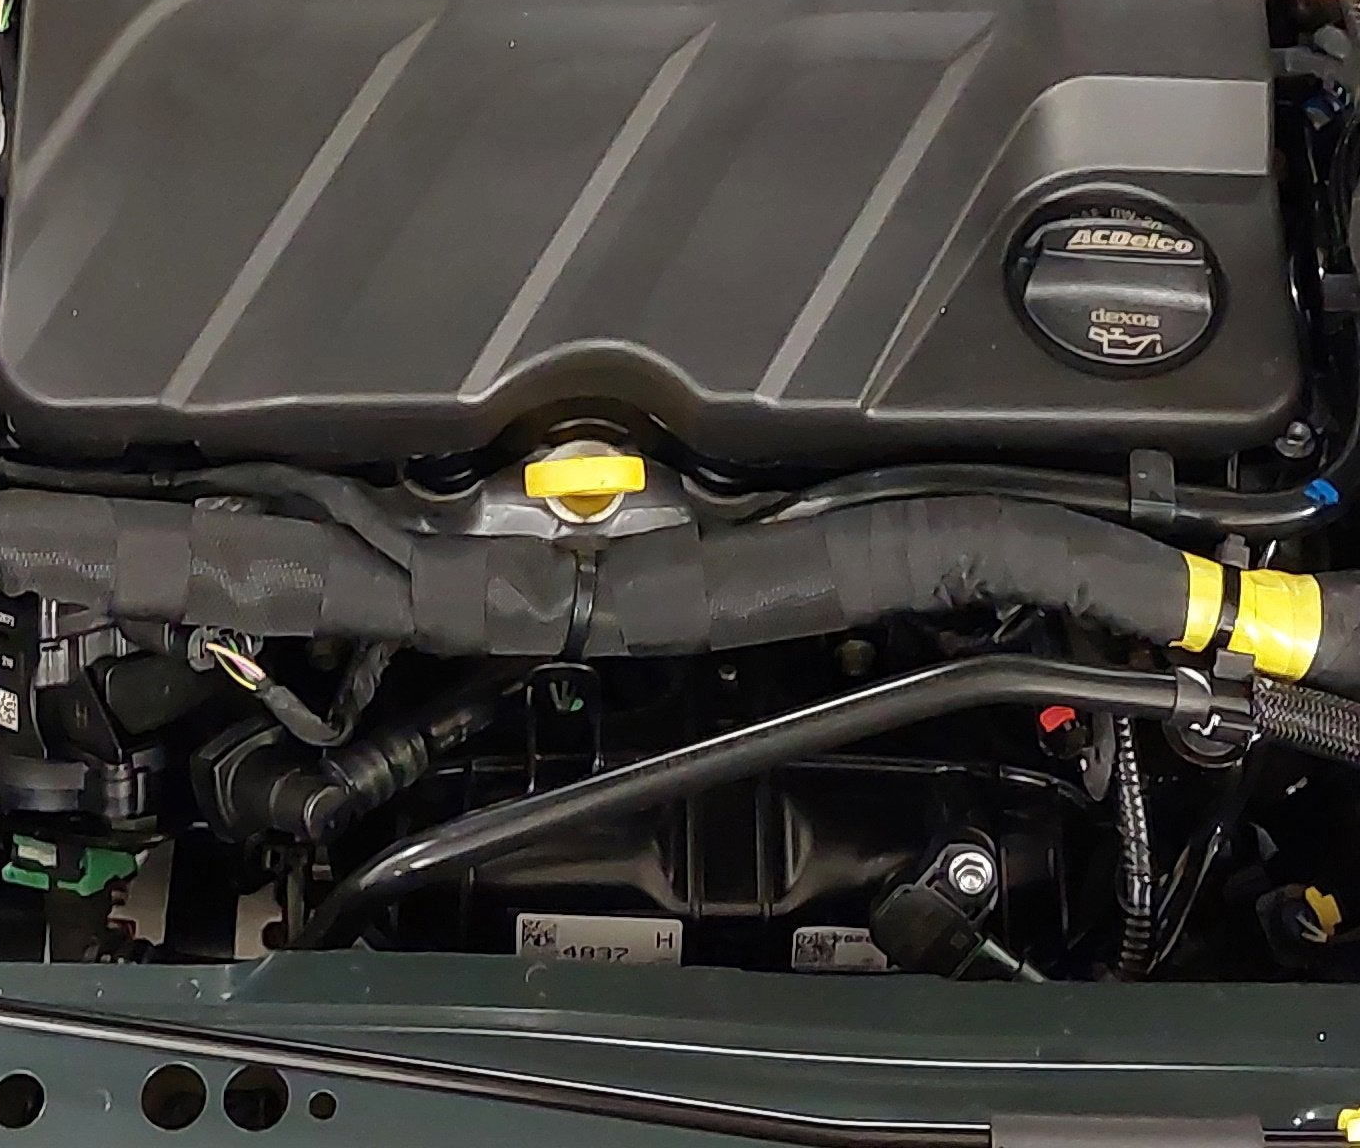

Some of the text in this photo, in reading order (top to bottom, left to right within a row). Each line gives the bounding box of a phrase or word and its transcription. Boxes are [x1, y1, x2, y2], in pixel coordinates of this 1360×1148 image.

[1066, 229, 1195, 253] ACDelco
[1090, 308, 1160, 329] dexos
[655, 931, 674, 949] H
